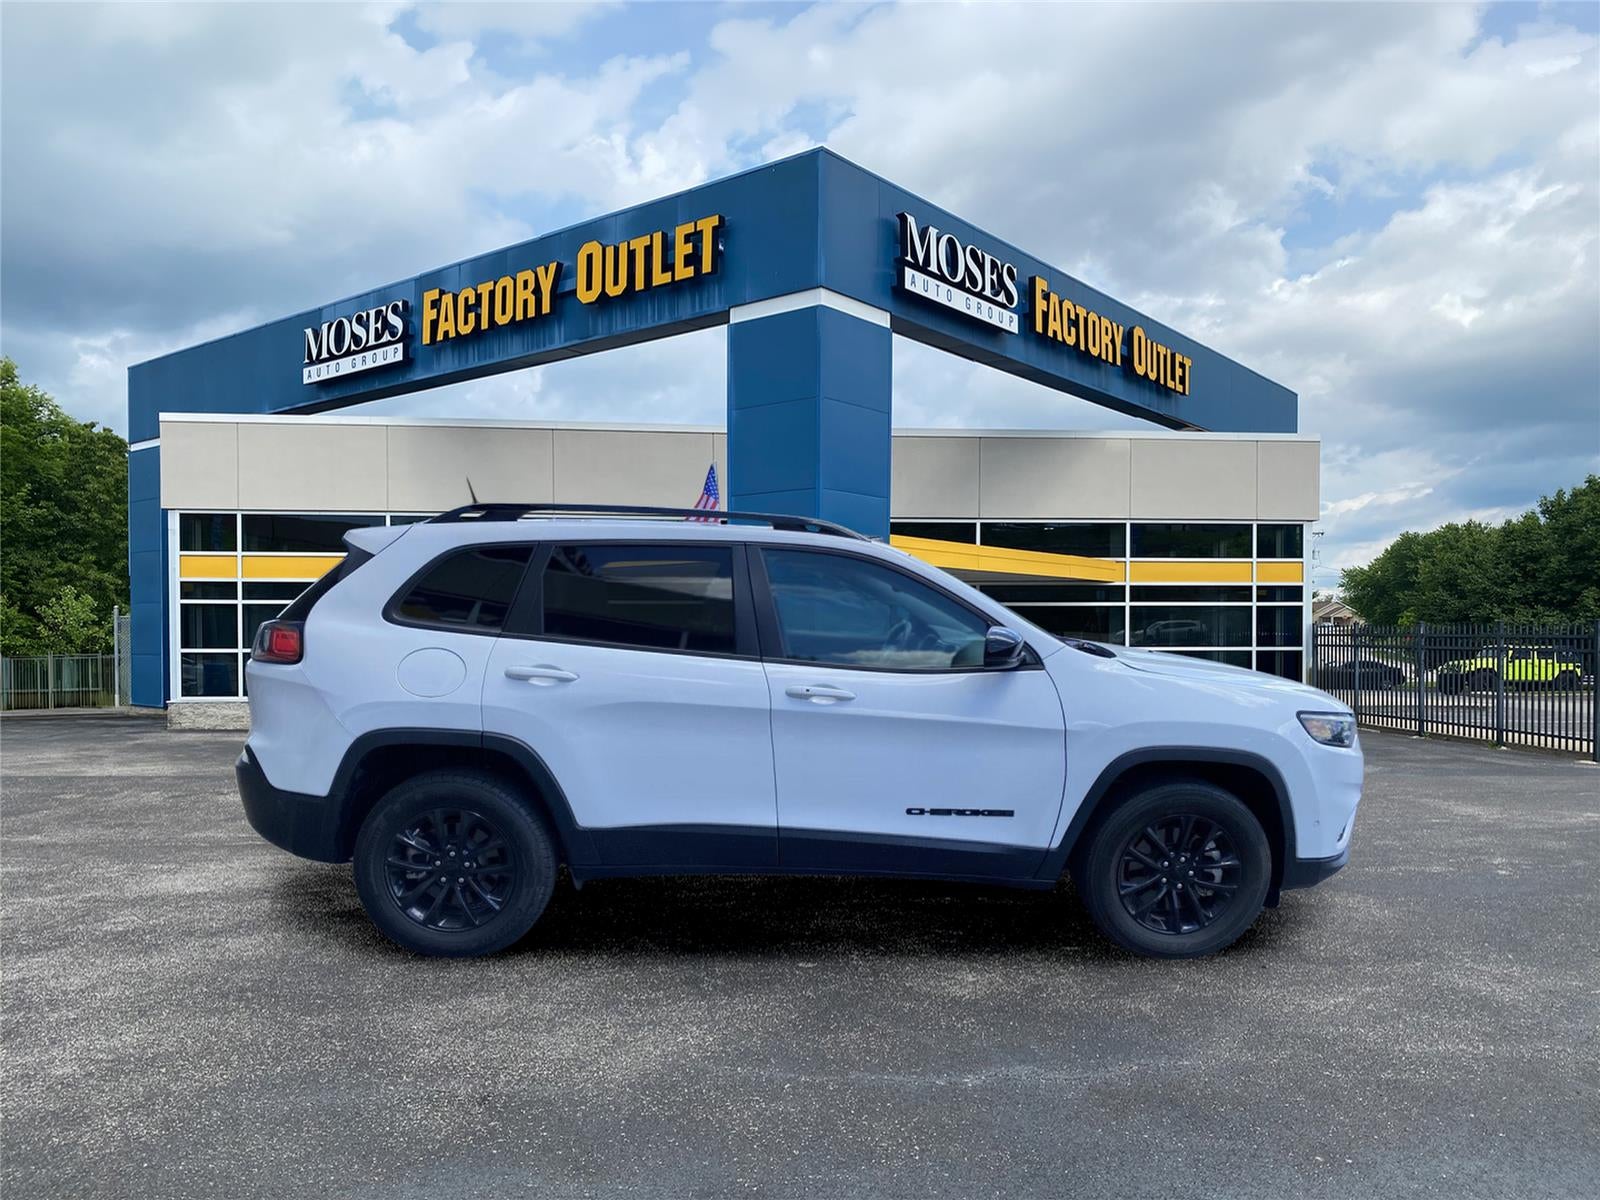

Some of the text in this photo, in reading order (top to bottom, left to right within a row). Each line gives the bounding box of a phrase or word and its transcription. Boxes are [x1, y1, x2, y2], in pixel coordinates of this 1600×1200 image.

[422, 214, 720, 345] FACTORY OUTLET
[903, 212, 1018, 308] MOSES
[303, 300, 404, 363] MOSES
[910, 273, 1015, 327] AUTO GROUP
[306, 347, 400, 381] AUTO GROUP
[1034, 275, 1192, 395] FACTORY OUTLET
[906, 808, 1014, 817] CHEROKEE
